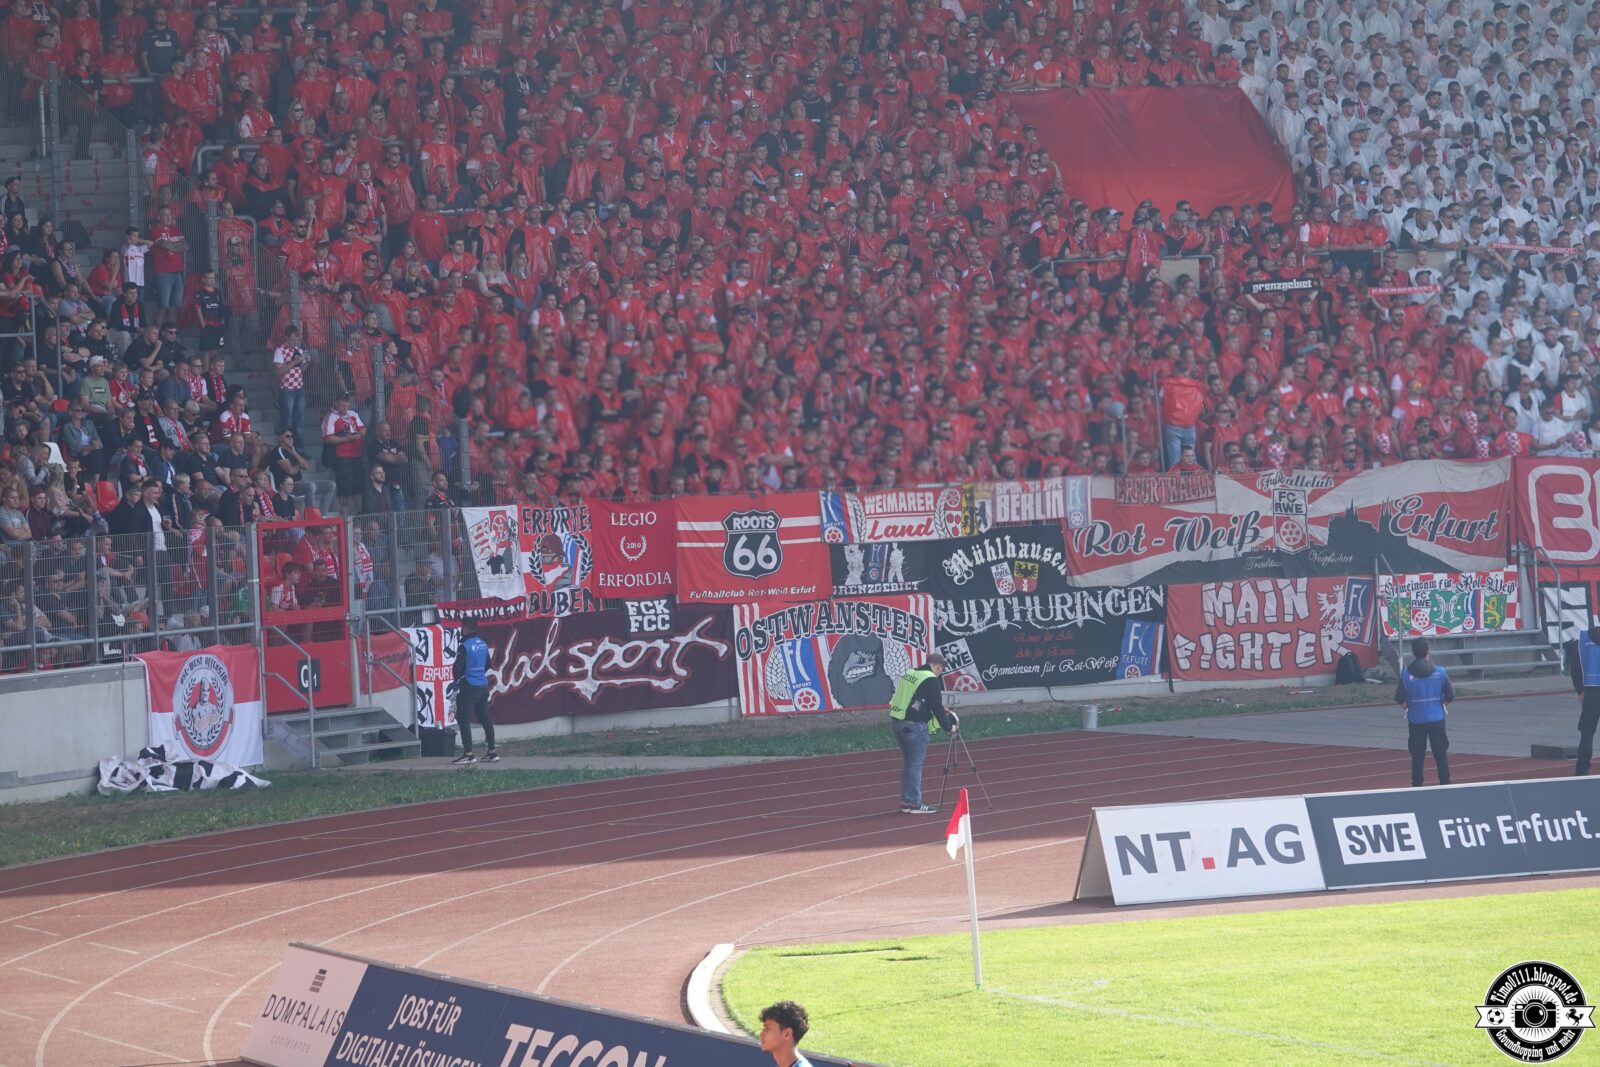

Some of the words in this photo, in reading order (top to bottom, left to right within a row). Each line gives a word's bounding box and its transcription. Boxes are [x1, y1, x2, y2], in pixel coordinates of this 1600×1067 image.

[864, 492, 935, 514] WEIMARER
[996, 489, 1065, 522] BERLIN
[1275, 503, 1304, 514] RWE
[1279, 492, 1297, 503] FC
[611, 511, 657, 526] LEGIO
[733, 515, 775, 530] ROOTS
[867, 517, 935, 540] Land
[1389, 495, 1498, 543] Erfurt
[626, 541, 642, 549] 2010
[733, 534, 778, 571] 66
[599, 571, 672, 587] ERFORDIA
[690, 589, 745, 599] Fußballclub
[790, 585, 817, 595] Erfurt
[1201, 577, 1310, 627] MAIN
[1411, 599, 1432, 607] RWE
[625, 599, 670, 615] FCK
[629, 615, 670, 632] FCC
[735, 600, 927, 661] OSTWANSTER
[485, 617, 560, 702] lack
[1173, 627, 1354, 671] FIGHTER
[982, 663, 1040, 682] Gemeinsam
[1041, 663, 1056, 677] für
[1343, 821, 1415, 856] SWE
[1438, 817, 1491, 849] Für
[1497, 808, 1600, 845] Erfurt.
[261, 994, 345, 1037] DOMPALAIS
[388, 993, 434, 1030] JOBS
[426, 996, 462, 1036] FÜR
[335, 1031, 406, 1067] DIGITALE
